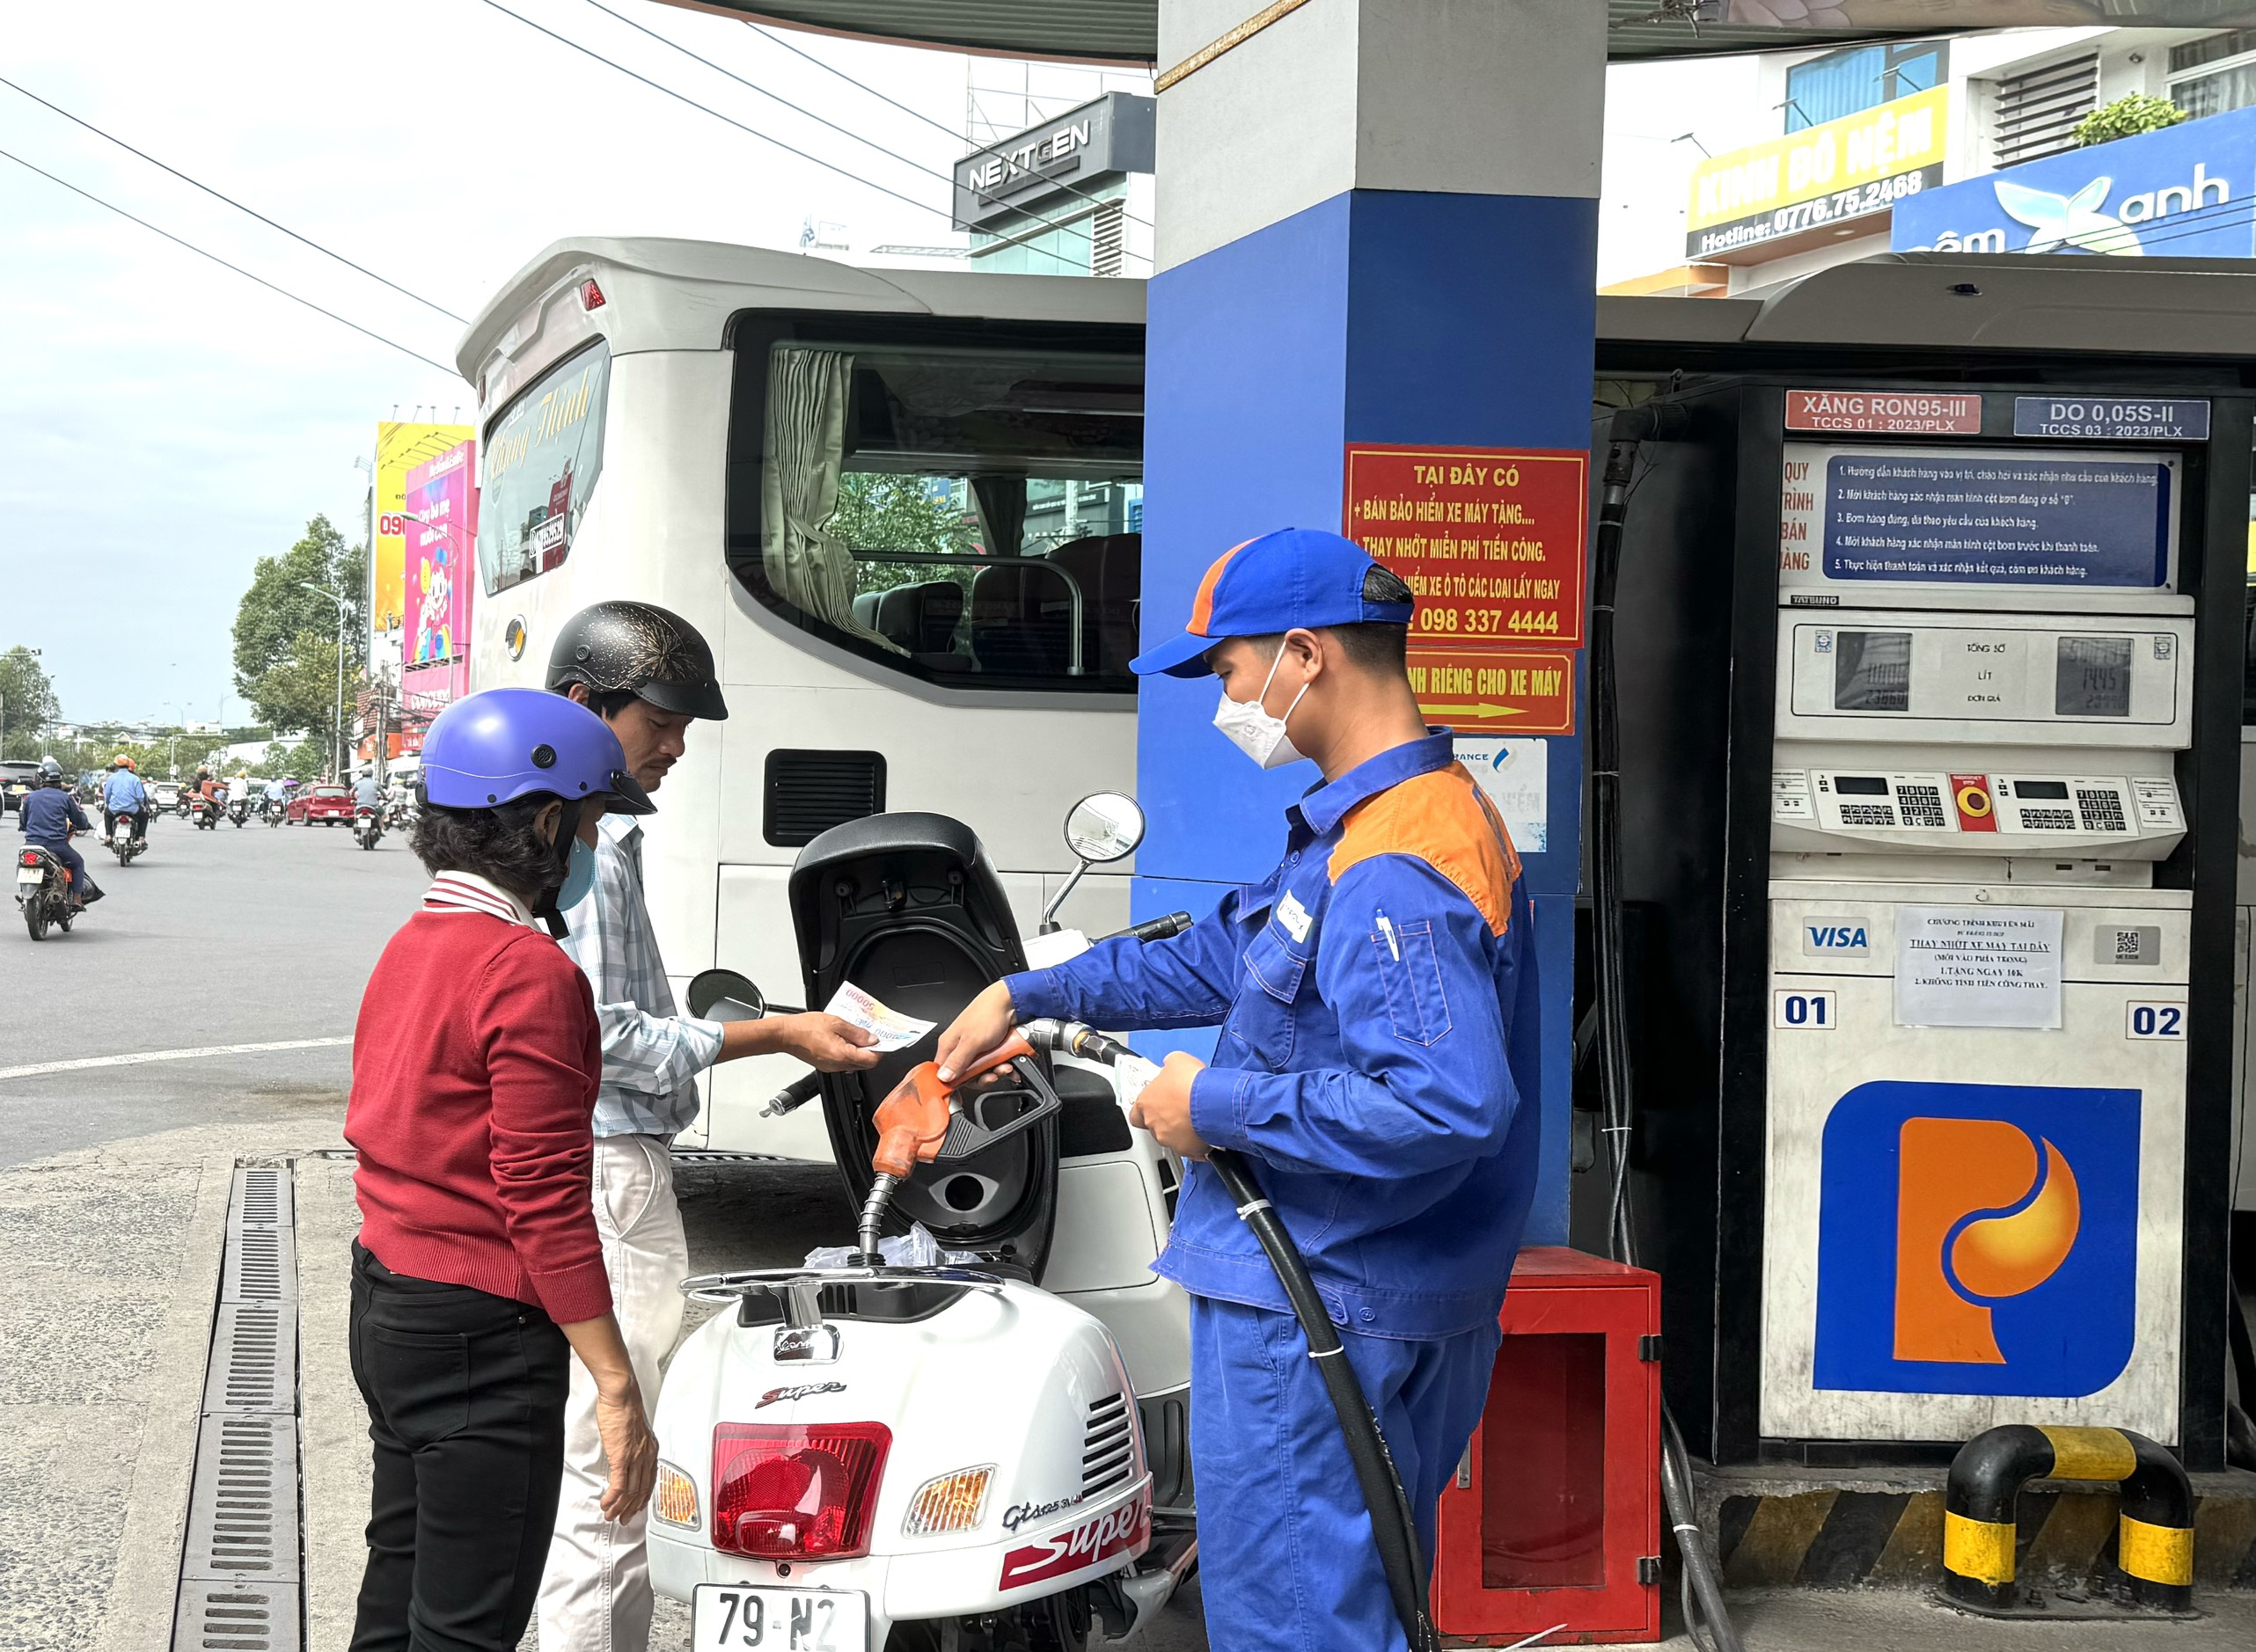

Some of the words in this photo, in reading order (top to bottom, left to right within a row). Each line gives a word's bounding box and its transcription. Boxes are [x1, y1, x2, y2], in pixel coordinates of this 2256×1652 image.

[970, 120, 1089, 191] NEXTGEN
[1697, 154, 1779, 218] KINH
[1788, 129, 1836, 193] ĐÔ
[1846, 106, 1932, 174] NỆM
[2119, 163, 2230, 224] anh
[1701, 221, 1770, 252] Hotline:
[1774, 171, 1923, 232] 0776.75.2468
[1803, 393, 1864, 414] XĂNG
[1871, 398, 1967, 417] RON95-III
[2050, 404, 2084, 420] DO
[2091, 405, 2173, 424] 0,05S-II
[1812, 416, 1852, 428] TCCS
[1857, 418, 1872, 428] 01
[1887, 419, 1955, 431] 2023/PLX
[2040, 423, 2081, 435] TCCS
[2085, 425, 2101, 435] 03
[2115, 426, 2183, 437] 2023/PLX
[1414, 465, 1444, 488] TẠI
[1449, 463, 1488, 486] ĐÂY
[1493, 464, 1520, 486] CÓ
[1784, 462, 1809, 483] QUY
[1840, 466, 1845, 475] 1.
[1838, 489, 1844, 499] 2.
[1364, 494, 1387, 520] BÁN
[1390, 493, 1413, 521] BẢO
[1416, 492, 1444, 522] HIỂM
[1447, 502, 1461, 523] XE
[1464, 498, 1489, 523] MÁY
[1837, 513, 1843, 523] 3.
[380, 515, 406, 535] 09
[1781, 517, 1806, 540] BÁN
[1363, 537, 1393, 558] THAY
[1395, 532, 1427, 558] NHỚT
[1430, 530, 1458, 559] MIỄN
[1461, 534, 1480, 559] PHÍ
[1512, 537, 1546, 561] CÔNG.
[1835, 536, 1842, 545] 4.
[1835, 559, 1841, 569] 5.
[1429, 576, 1442, 596] XE
[1444, 572, 1451, 596] Ô
[1454, 572, 1466, 596] TÔ
[1469, 572, 1487, 597] CÁC
[1490, 577, 1512, 603] LOẠI
[1513, 571, 1532, 598] LẤY
[1534, 579, 1561, 599] NGAY
[1420, 608, 1458, 632] 098
[1464, 609, 1502, 632] 337
[1508, 610, 1559, 633] 4444
[1432, 663, 1473, 695] RIÊNG
[1477, 669, 1506, 695] CHO
[1511, 669, 1527, 695] XE
[1531, 666, 1562, 696] MÁY
[1806, 925, 1868, 948] VISA
[1910, 939, 1937, 948] THAY
[1785, 996, 1826, 1025] 01
[2133, 1007, 2180, 1035] 02
[755, 1382, 847, 1409] Super
